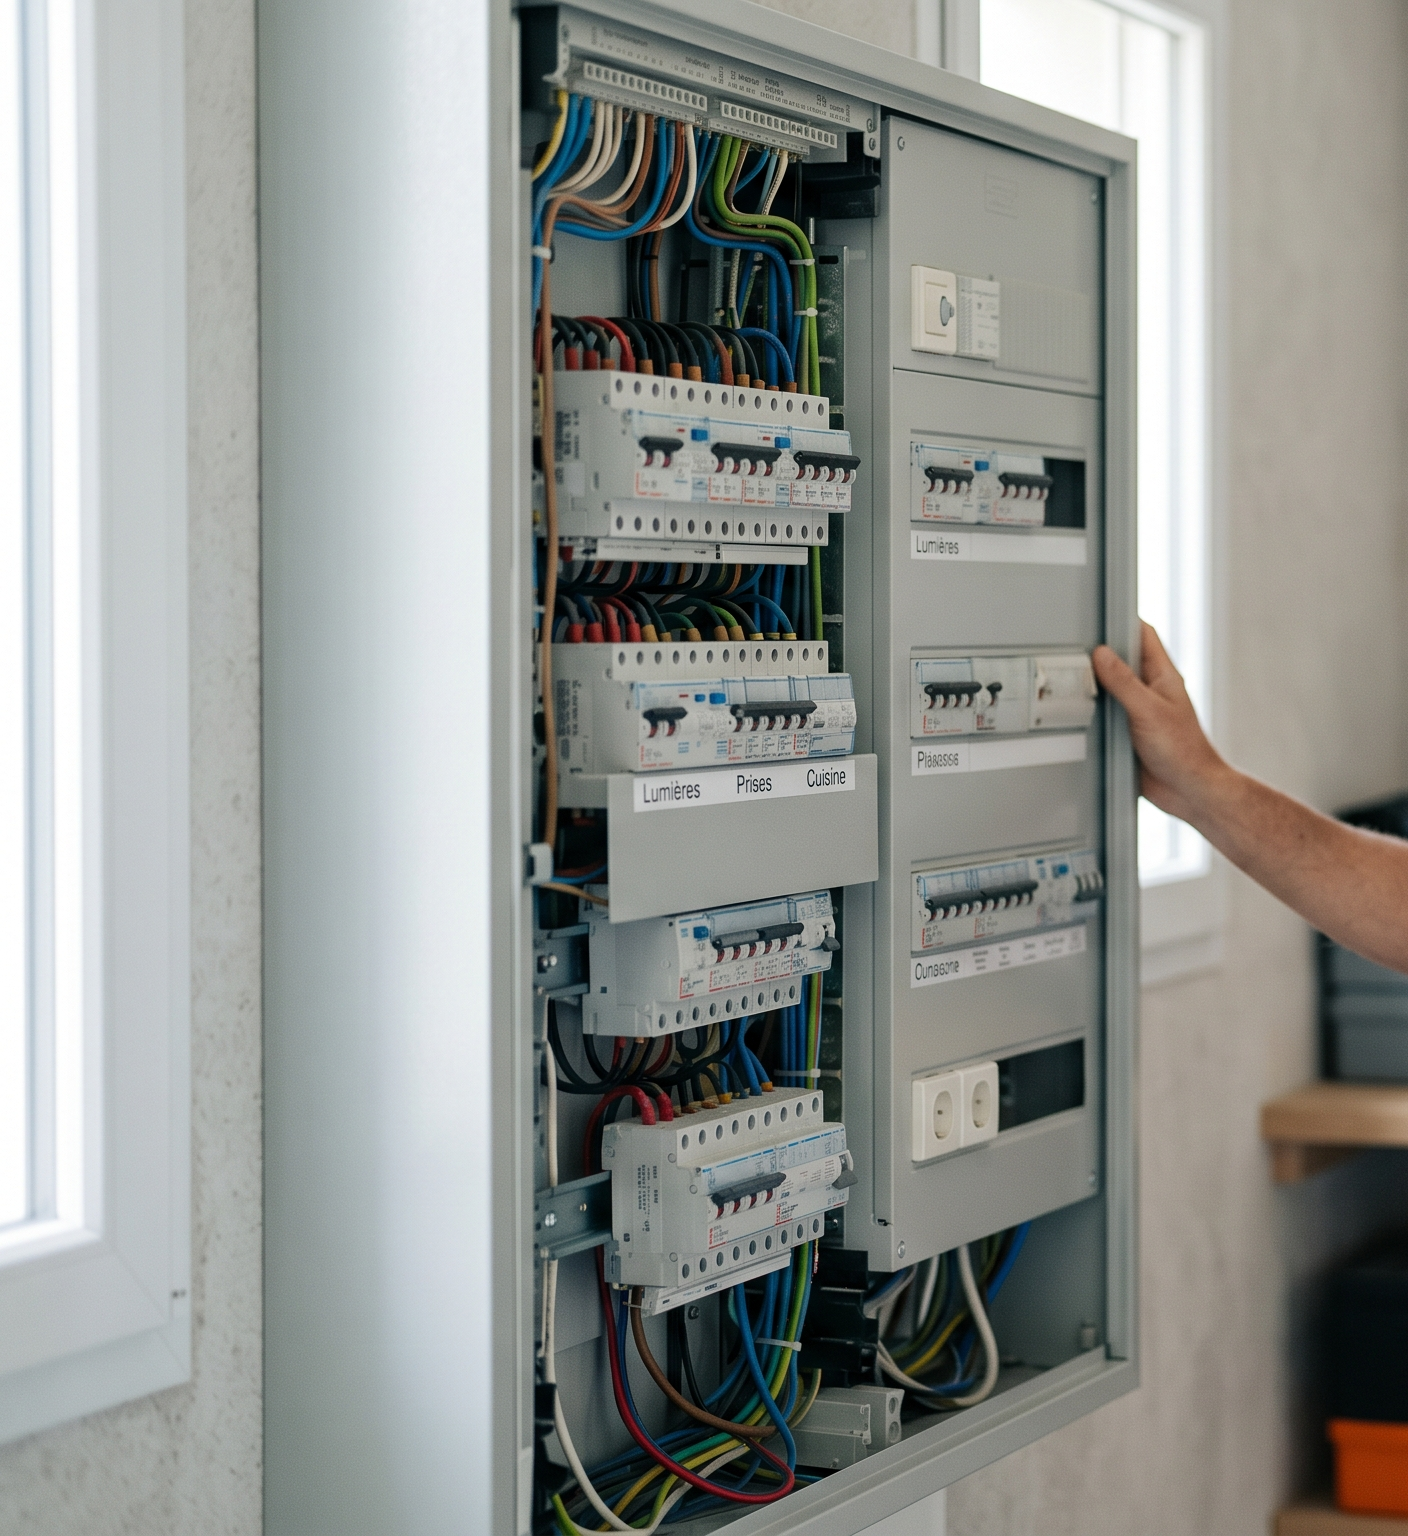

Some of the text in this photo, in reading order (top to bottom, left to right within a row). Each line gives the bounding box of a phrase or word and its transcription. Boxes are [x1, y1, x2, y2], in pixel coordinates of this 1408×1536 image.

[916, 535, 960, 555] Lumières
[643, 767, 847, 803] Lumières Prises Cuisine
